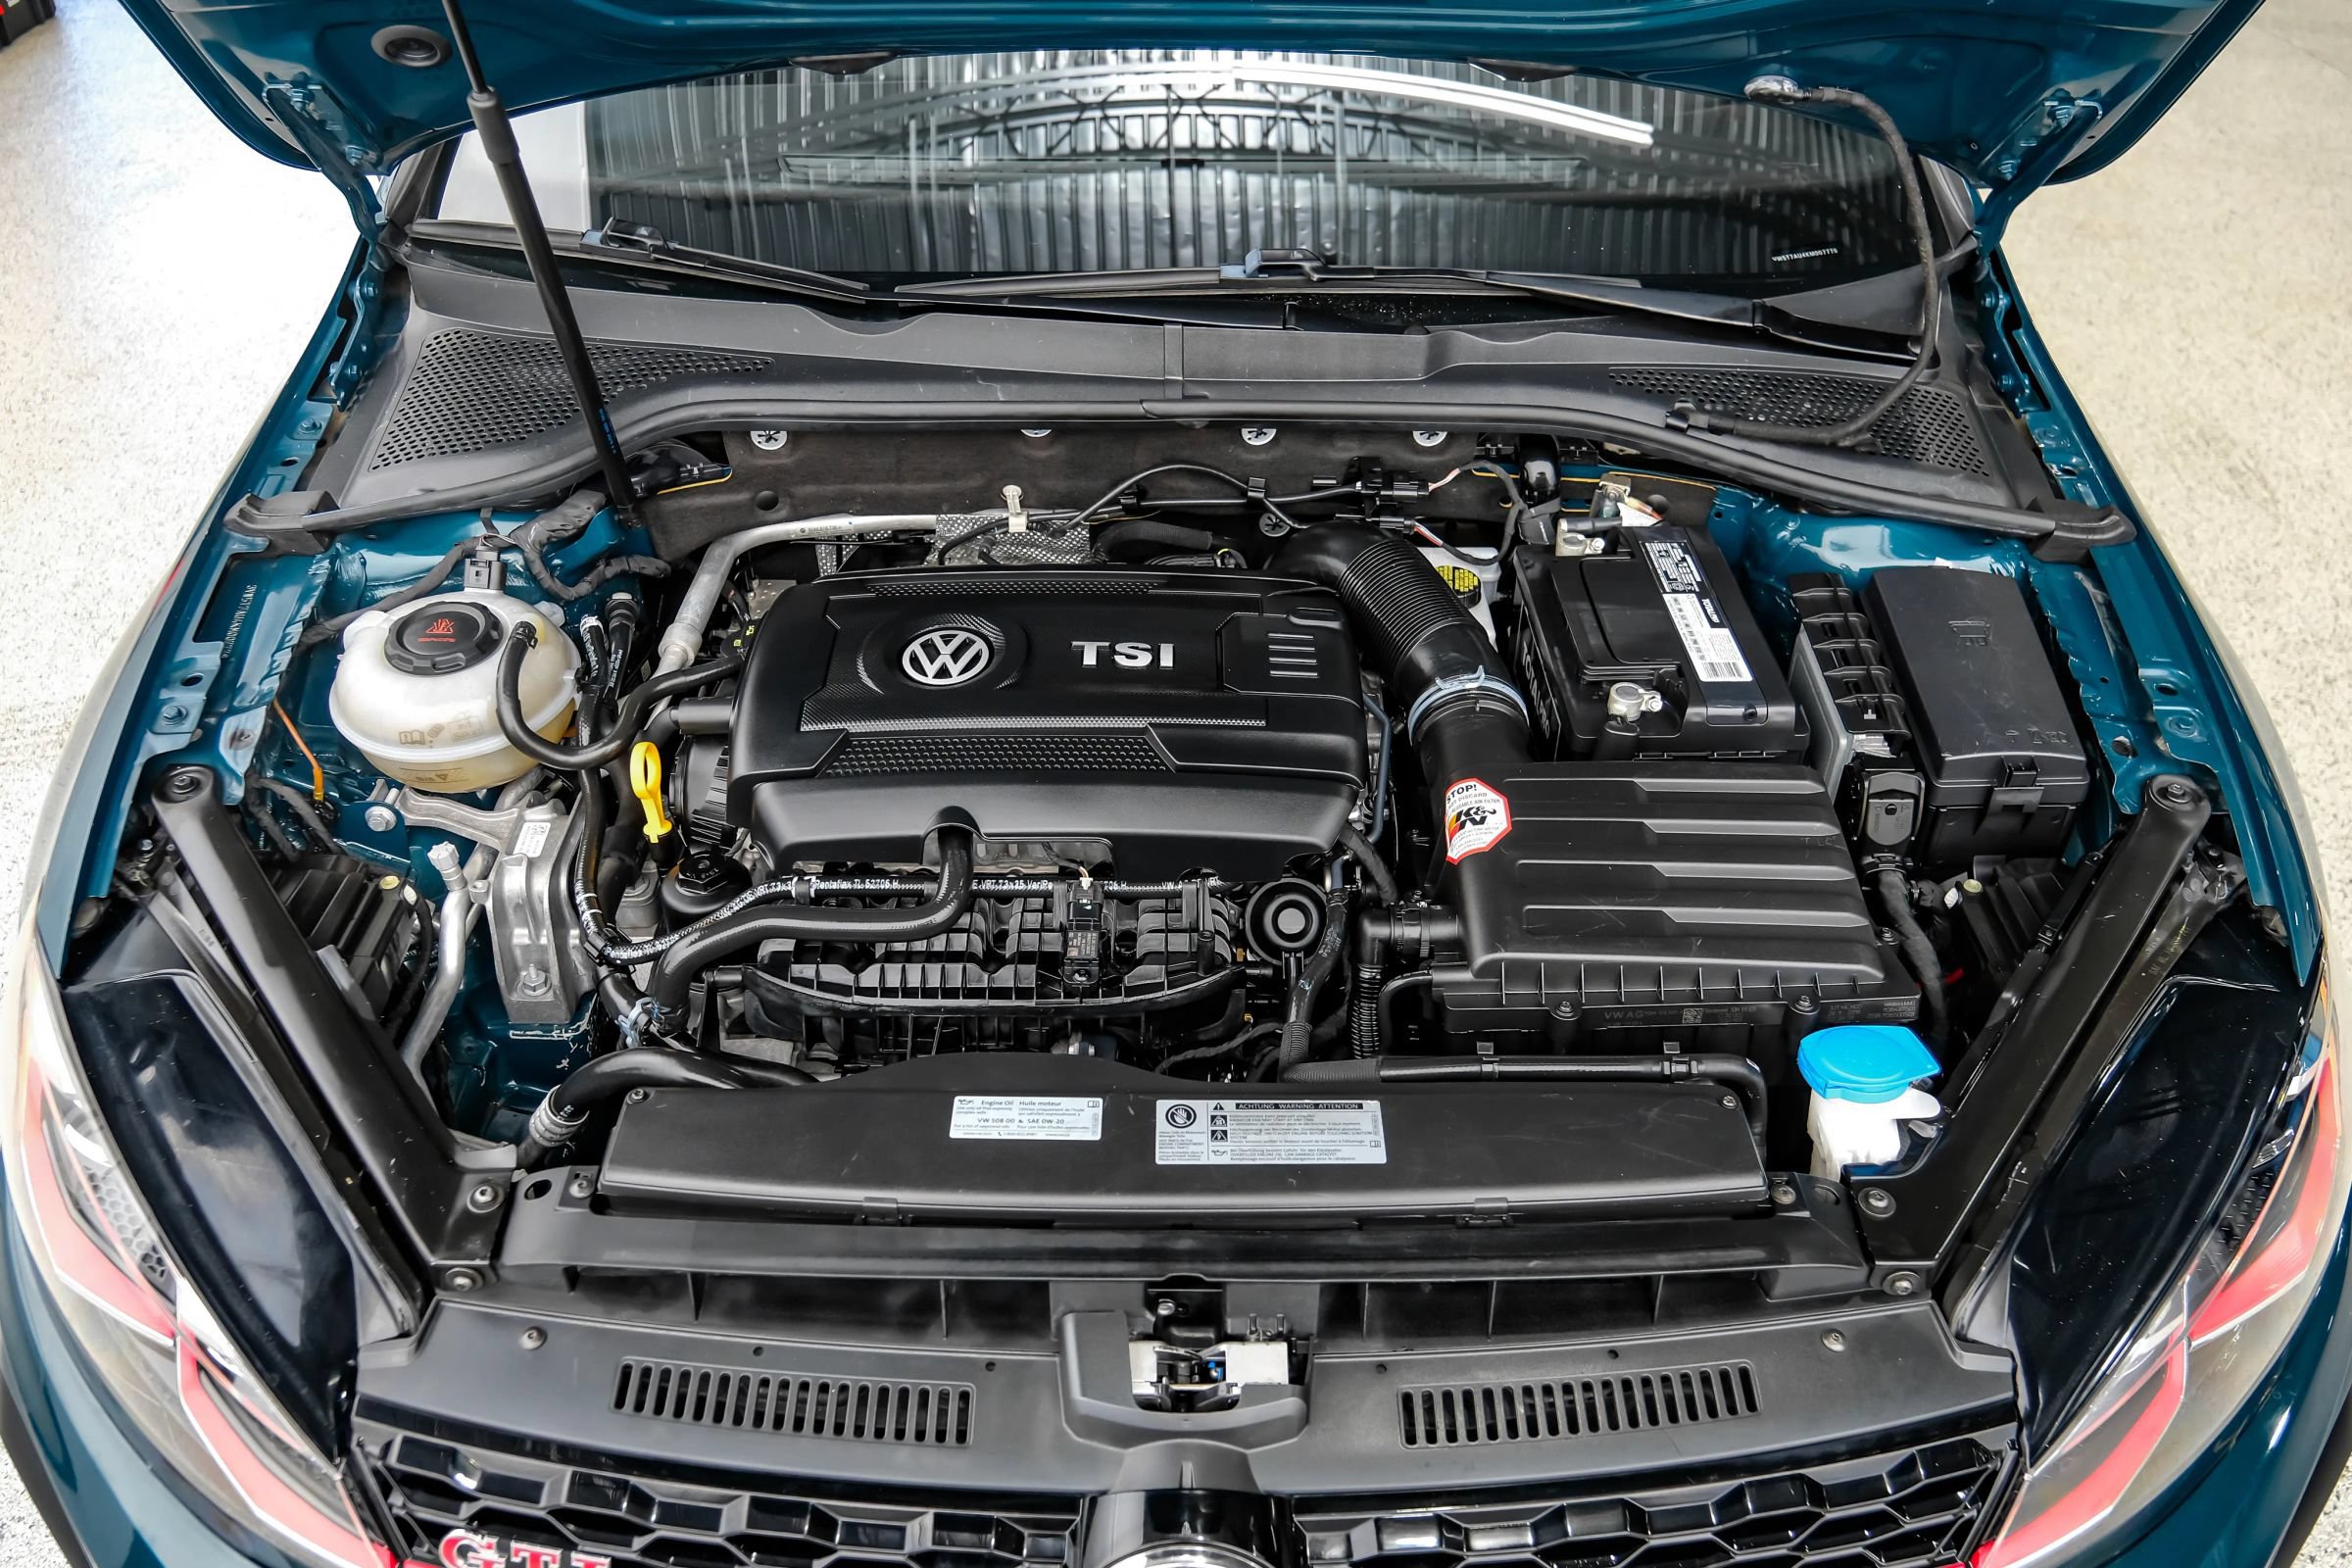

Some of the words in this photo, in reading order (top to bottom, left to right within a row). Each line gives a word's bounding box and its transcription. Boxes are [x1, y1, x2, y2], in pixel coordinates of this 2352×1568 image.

[902, 630, 991, 686] VW
[1070, 641, 1175, 669] TSI
[1446, 784, 1477, 804] STOP!
[1626, 1010, 1644, 1019] AG
